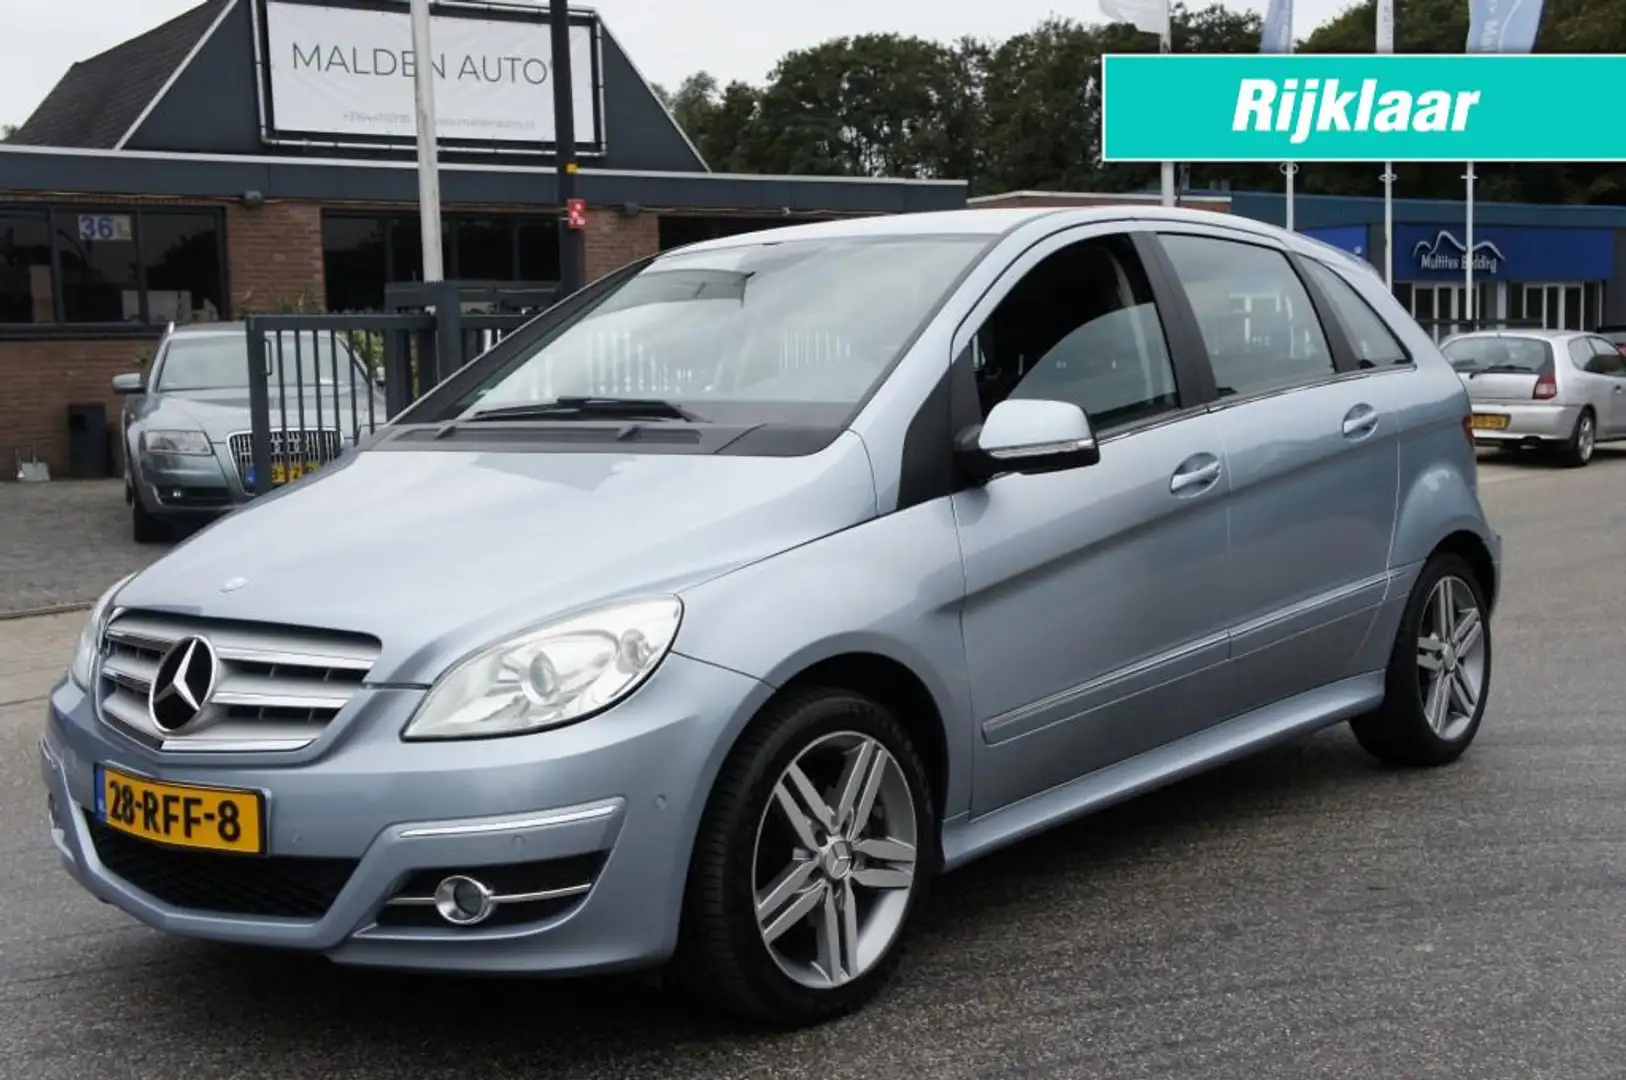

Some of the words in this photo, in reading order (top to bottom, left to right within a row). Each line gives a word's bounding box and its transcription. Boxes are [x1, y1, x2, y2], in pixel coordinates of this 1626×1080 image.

[292, 42, 446, 80] MALDEN
[457, 55, 555, 85] AUTO
[1460, 254, 1498, 275] Bdding
[109, 779, 241, 843] 28-RFF-8
